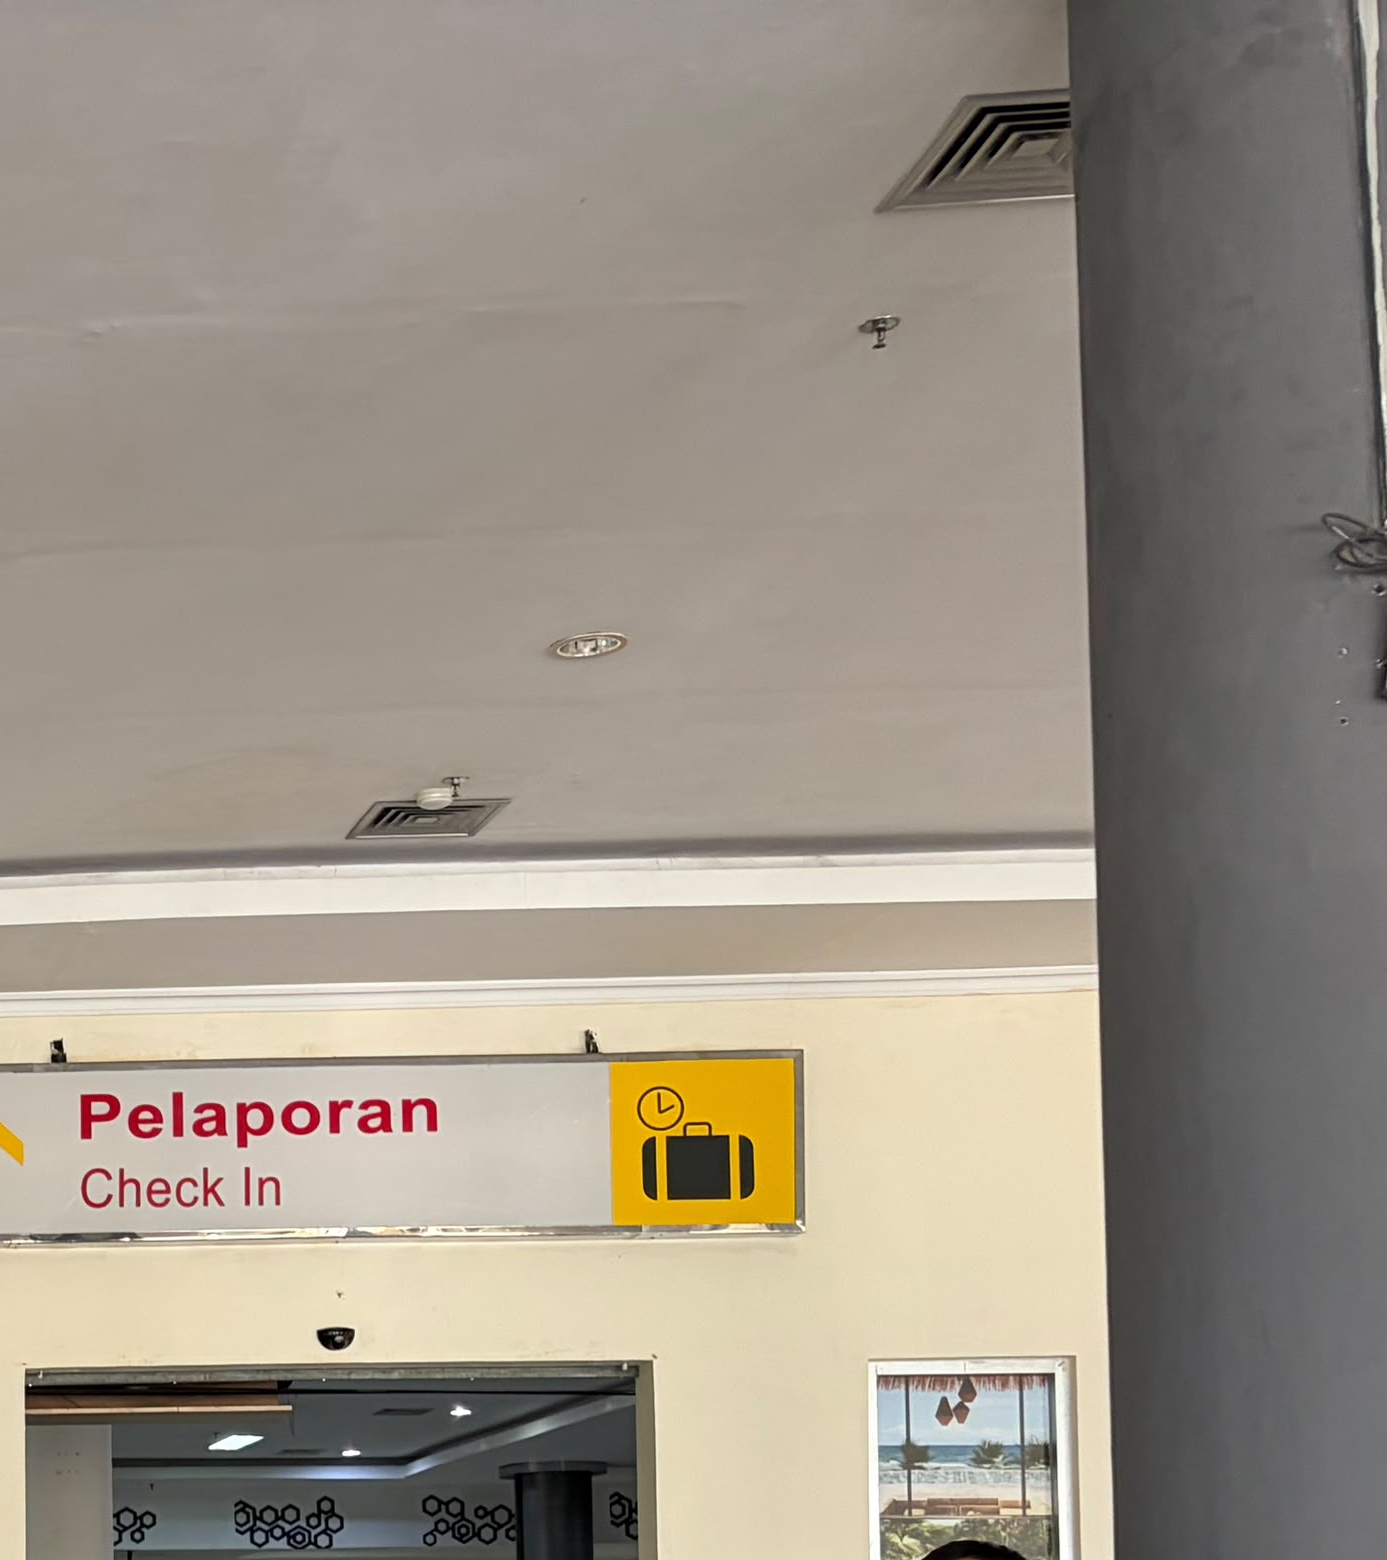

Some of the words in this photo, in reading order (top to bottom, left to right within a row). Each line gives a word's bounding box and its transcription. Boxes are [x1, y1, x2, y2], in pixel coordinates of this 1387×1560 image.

[79, 1091, 439, 1148] Pelaporan
[80, 1166, 225, 1209] Check
[244, 1166, 282, 1207] In
